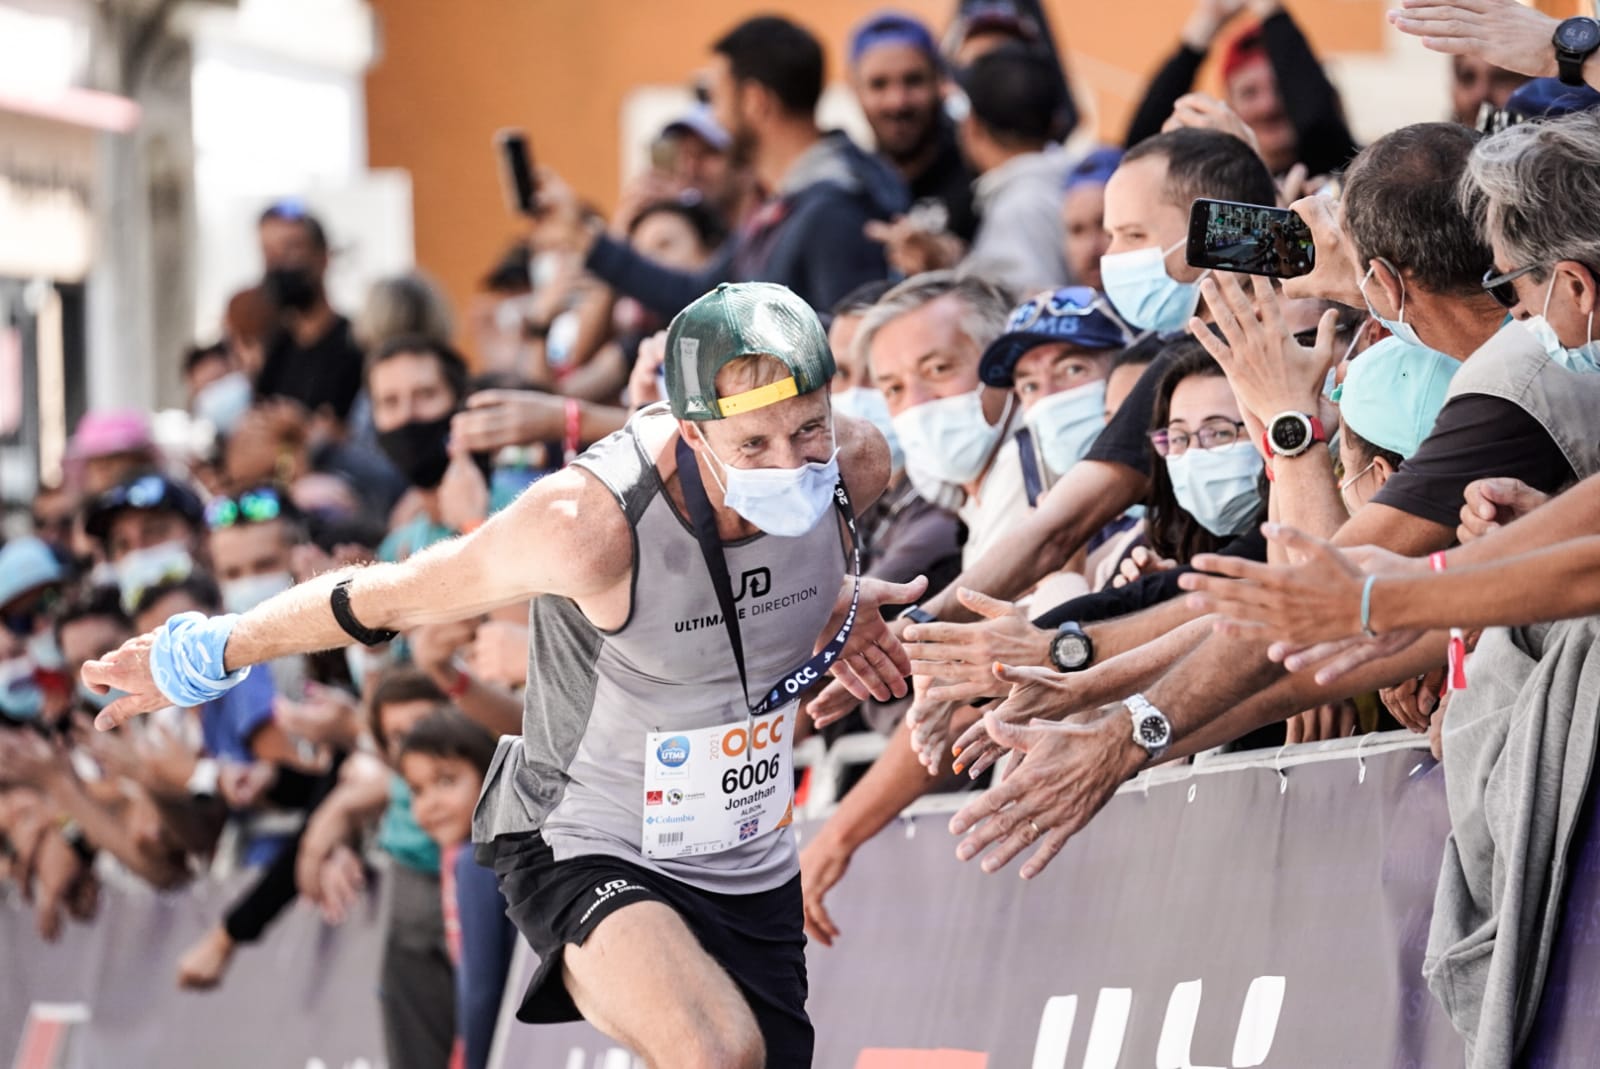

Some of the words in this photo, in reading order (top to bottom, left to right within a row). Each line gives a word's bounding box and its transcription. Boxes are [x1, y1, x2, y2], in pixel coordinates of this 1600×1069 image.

[674, 607, 746, 633] ULTIMAE
[751, 586, 817, 616] DIRECTION
[784, 666, 818, 694] OCC
[722, 714, 784, 757] OCC
[722, 753, 780, 794] 6006
[725, 785, 776, 810] Jonathan
[740, 804, 762, 817] ALBON
[655, 814, 695, 824] Columbia
